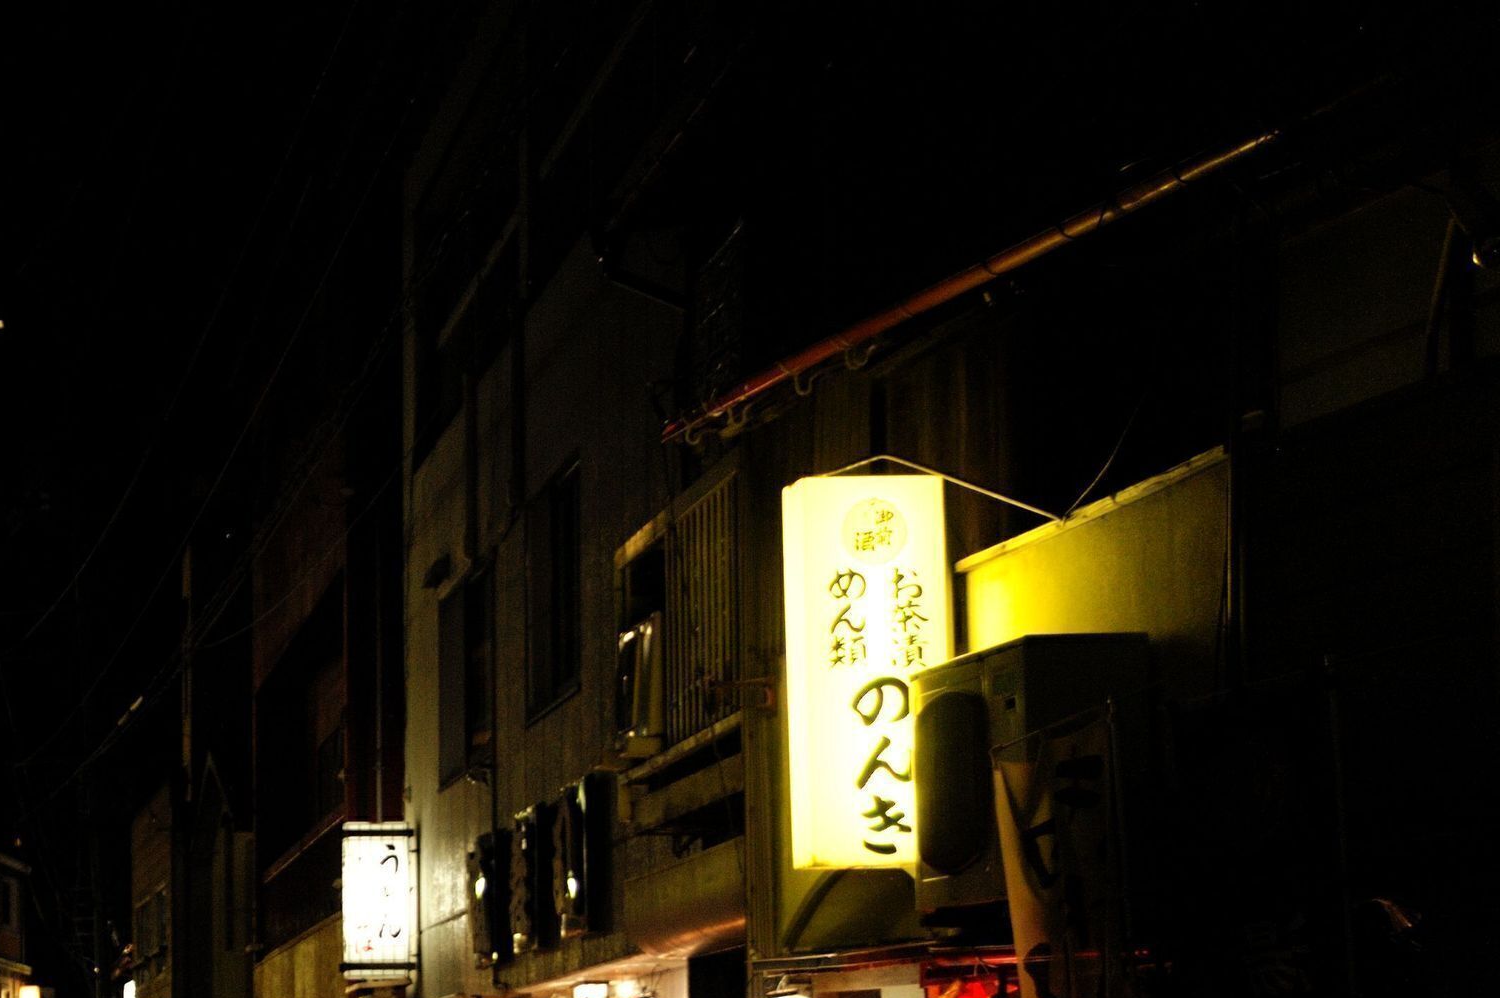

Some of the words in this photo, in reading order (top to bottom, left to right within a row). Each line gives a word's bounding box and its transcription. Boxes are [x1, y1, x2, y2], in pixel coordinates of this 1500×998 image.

[828, 567, 867, 668] めん類
[892, 567, 929, 668] お茶漬
[851, 676, 912, 855] のんき
[379, 843, 402, 939] うん
